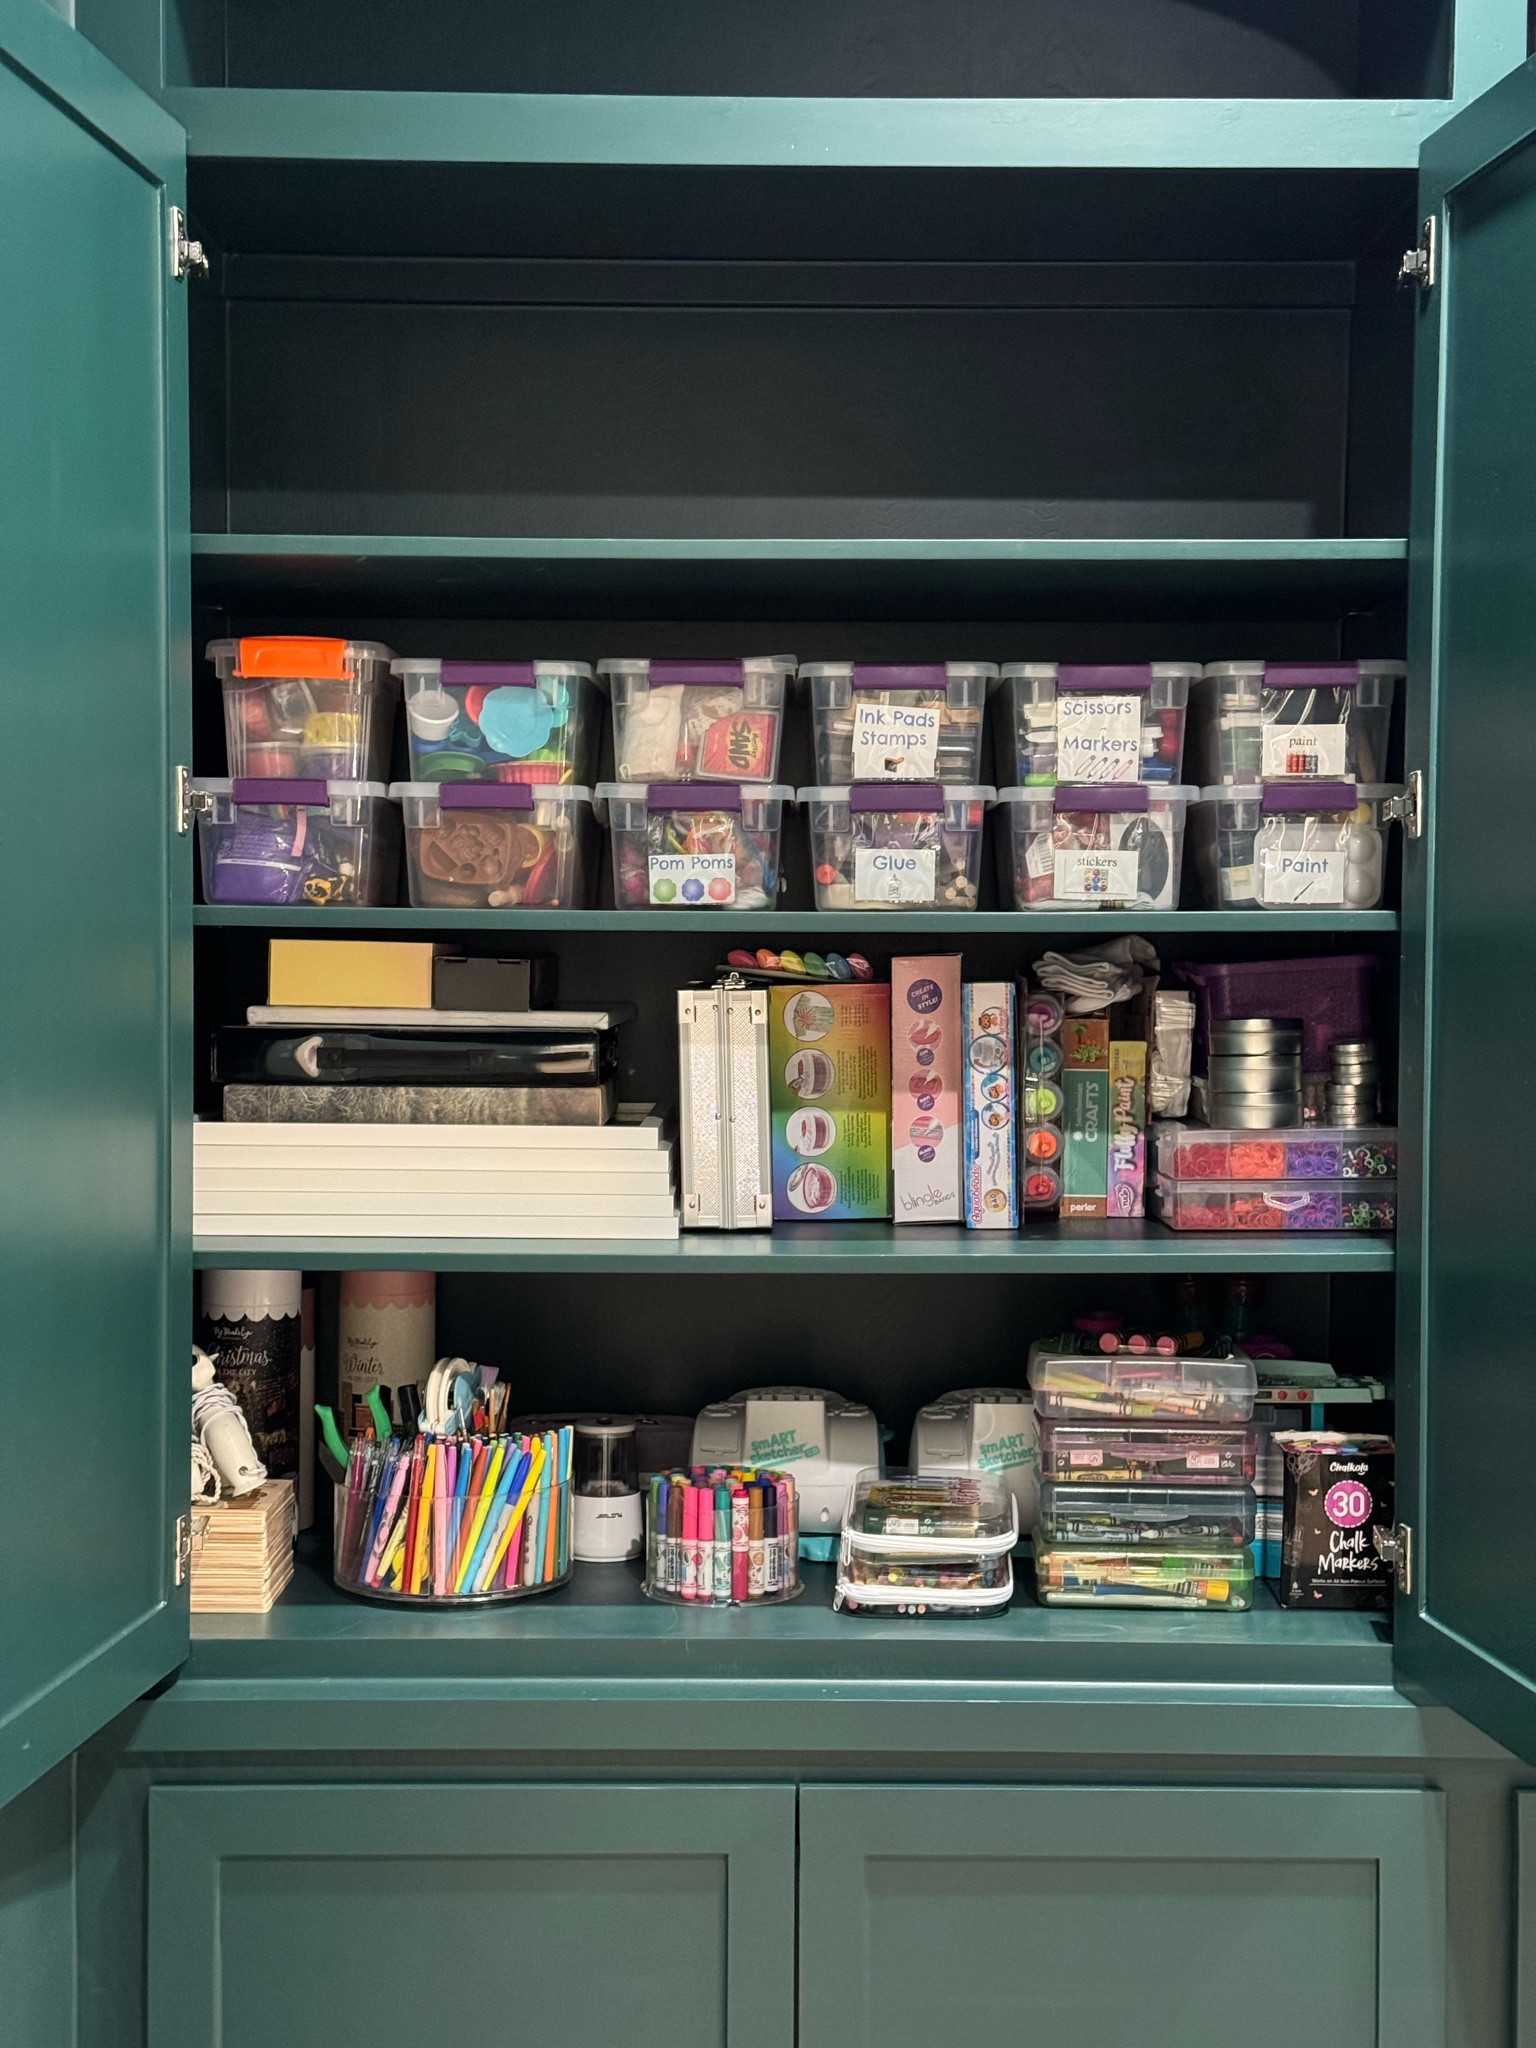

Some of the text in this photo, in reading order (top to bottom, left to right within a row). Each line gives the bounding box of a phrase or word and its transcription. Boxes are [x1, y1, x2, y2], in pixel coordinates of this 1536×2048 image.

[859, 708, 935, 728] Ink Pads
[1062, 700, 1132, 716] Scissors
[728, 719, 752, 770] SAND
[860, 730, 927, 750] Stamps
[1063, 735, 1138, 752] Markers
[1288, 736, 1317, 748] paint
[649, 855, 734, 871] Pom Poms
[872, 854, 917, 871] Glue
[1076, 855, 1118, 867] stickers
[1281, 857, 1329, 873] Paint
[910, 983, 935, 998] CREATE
[921, 993, 929, 1001] IN
[917, 996, 939, 1010] STYLE!
[1075, 1083, 1084, 1127] Smithsonian
[1112, 1076, 1137, 1122] Paint
[1084, 1081, 1100, 1143] CRAFTS
[1113, 1124, 1139, 1173] Fluffy
[899, 1184, 943, 1211] blingle
[933, 1191, 956, 1206] BANDS
[970, 1164, 984, 1223] Aquabeads
[1070, 1202, 1097, 1214] perler
[343, 1352, 385, 1375] Winter
[751, 1429, 797, 1452] smART
[979, 1433, 1024, 1455] smART
[749, 1441, 808, 1465] sketcher
[1329, 1461, 1369, 1476] Chalkola
[1332, 1490, 1366, 1518] 30
[1329, 1530, 1370, 1554] Chalk
[1317, 1551, 1379, 1575] Markers
